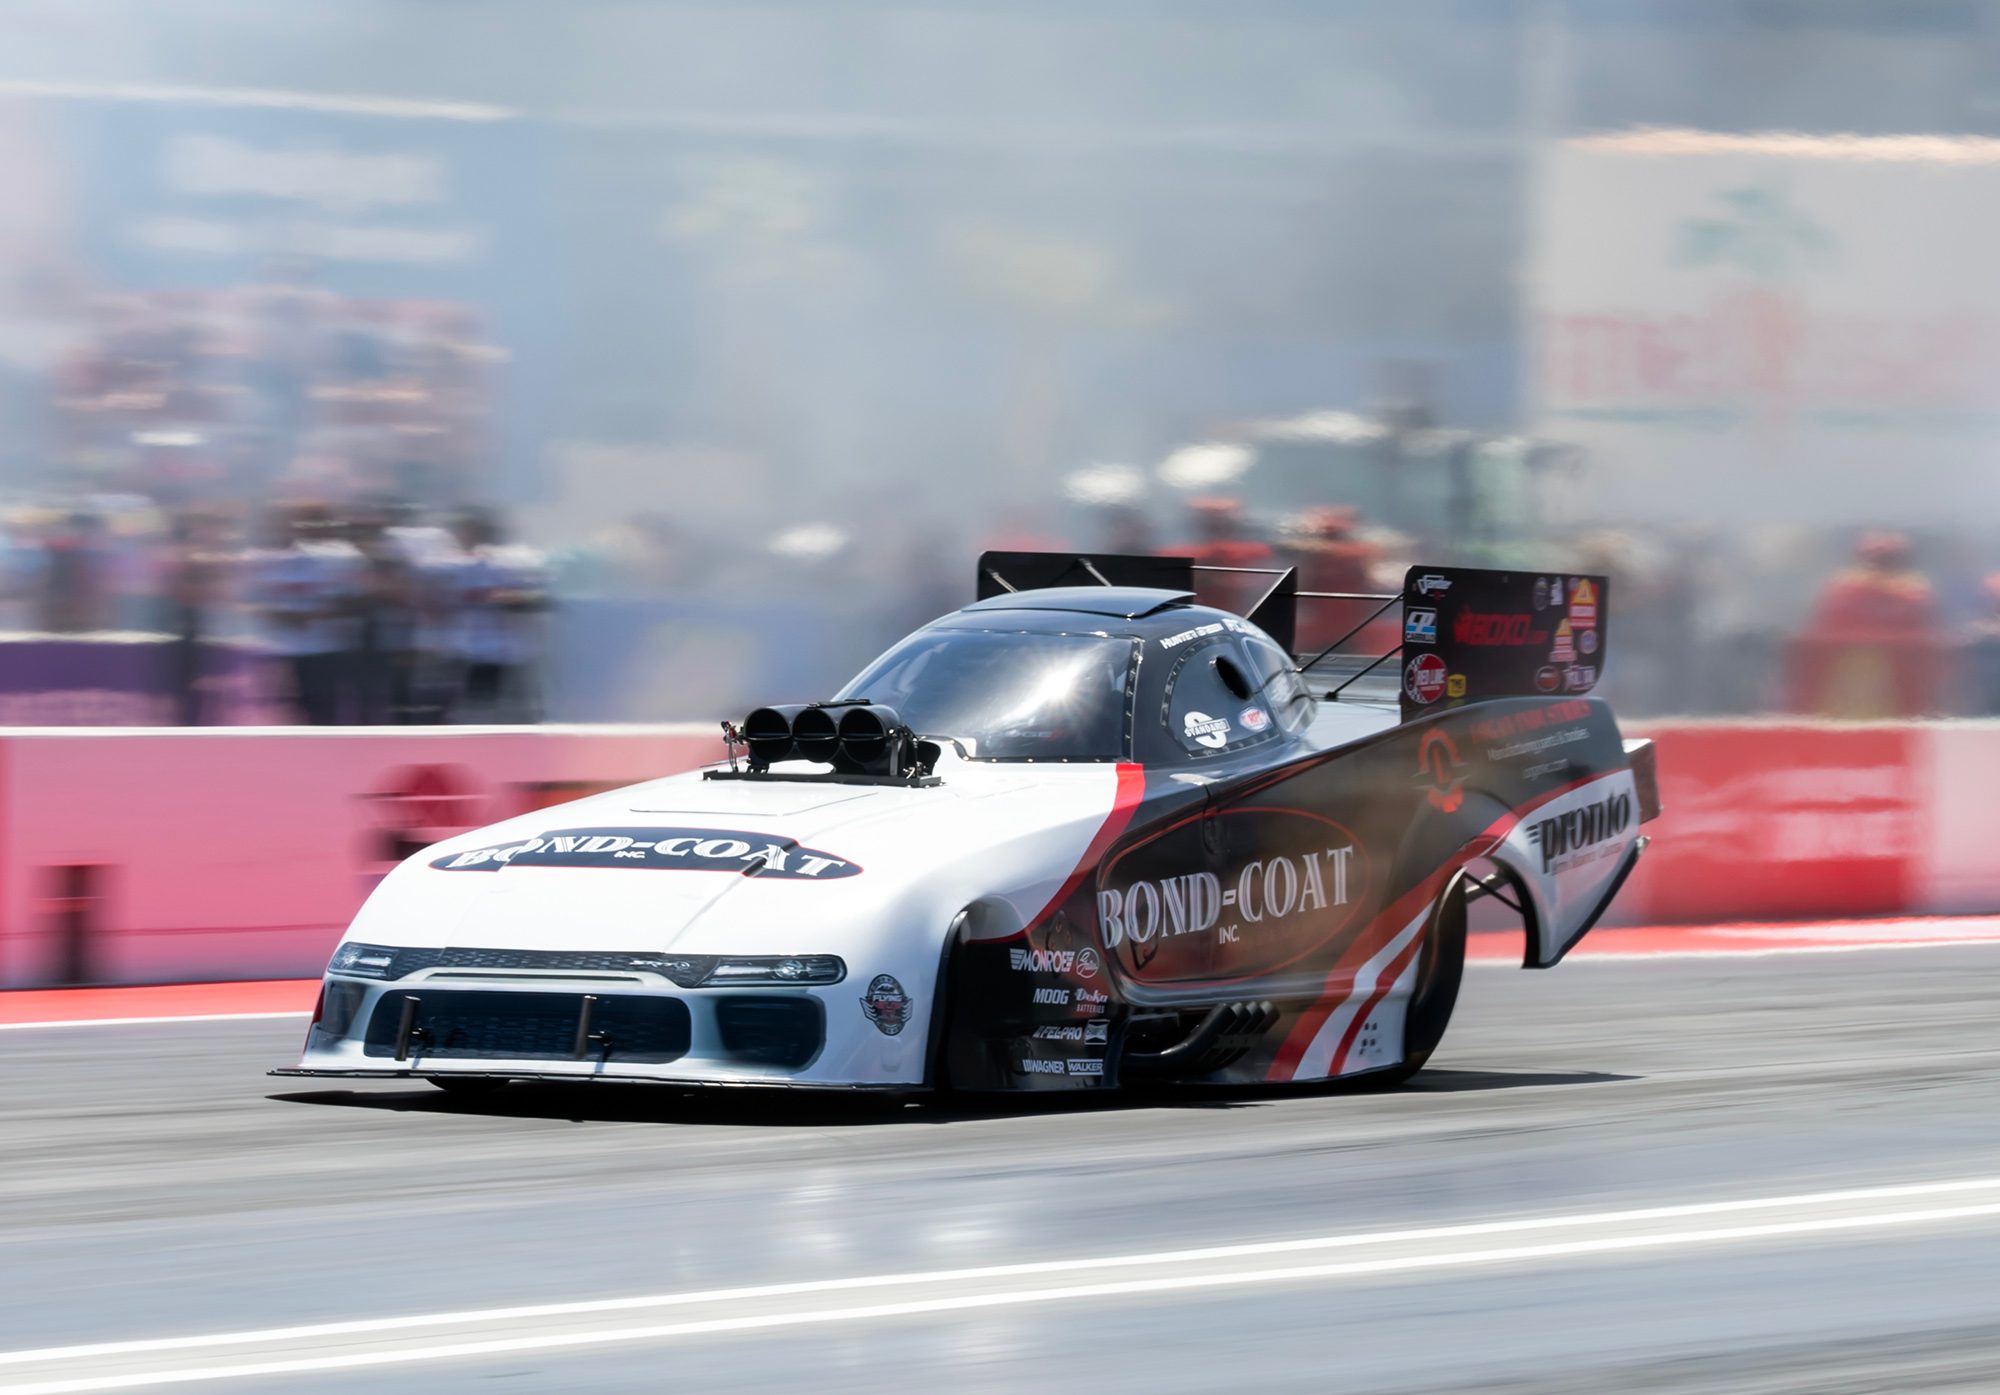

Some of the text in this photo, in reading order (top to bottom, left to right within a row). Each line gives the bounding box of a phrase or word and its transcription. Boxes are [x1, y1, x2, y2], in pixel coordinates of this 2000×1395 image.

[1184, 721, 1228, 737] STANDARD
[1540, 789, 1631, 874] pronto
[445, 836, 846, 876] BOND-COAT
[1097, 845, 1354, 949] BOND-COAT
[1019, 949, 1074, 972] MONROE
[1033, 988, 1069, 1005] MOOG
[1076, 1004, 1105, 1013] BATTERIES
[1031, 1060, 1065, 1074] WAGNER
[1068, 1063, 1103, 1073] WALKER
